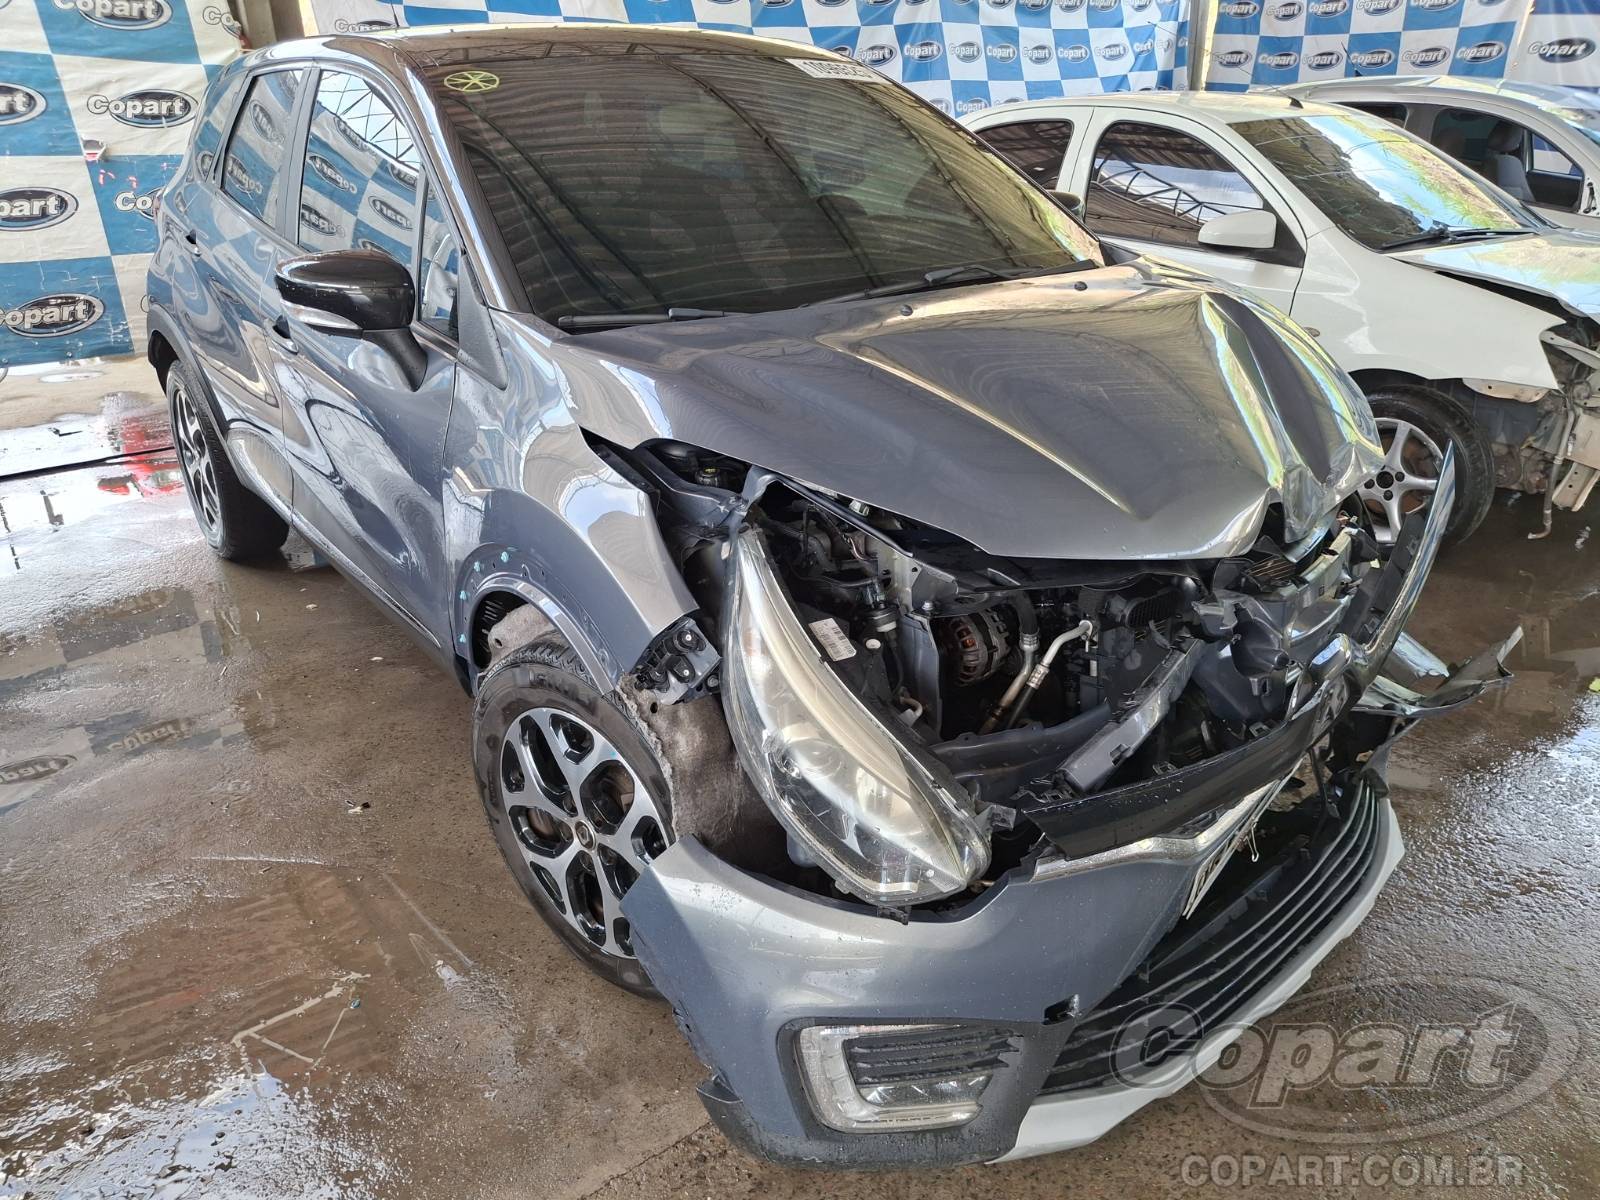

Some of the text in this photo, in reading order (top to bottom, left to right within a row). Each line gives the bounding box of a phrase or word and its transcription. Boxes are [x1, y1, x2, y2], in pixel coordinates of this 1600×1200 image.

[1219, 3, 1254, 15] Copart
[1265, 3, 1300, 16] Copart
[1308, 1, 1345, 13] Copart
[904, 42, 939, 56] Copart
[950, 44, 978, 56] Copart
[986, 46, 1014, 58] Copart
[1022, 47, 1050, 58] Copart
[1058, 47, 1087, 58] Copart
[1095, 45, 1125, 58] Copart
[1457, 43, 1499, 58] Copart
[1528, 41, 1588, 55] Copart
[1259, 52, 1295, 65] Copart
[1301, 53, 1340, 66] Copart
[1351, 51, 1389, 64] Copart
[1402, 48, 1445, 62] Copart
[86, 94, 184, 118] Copart
